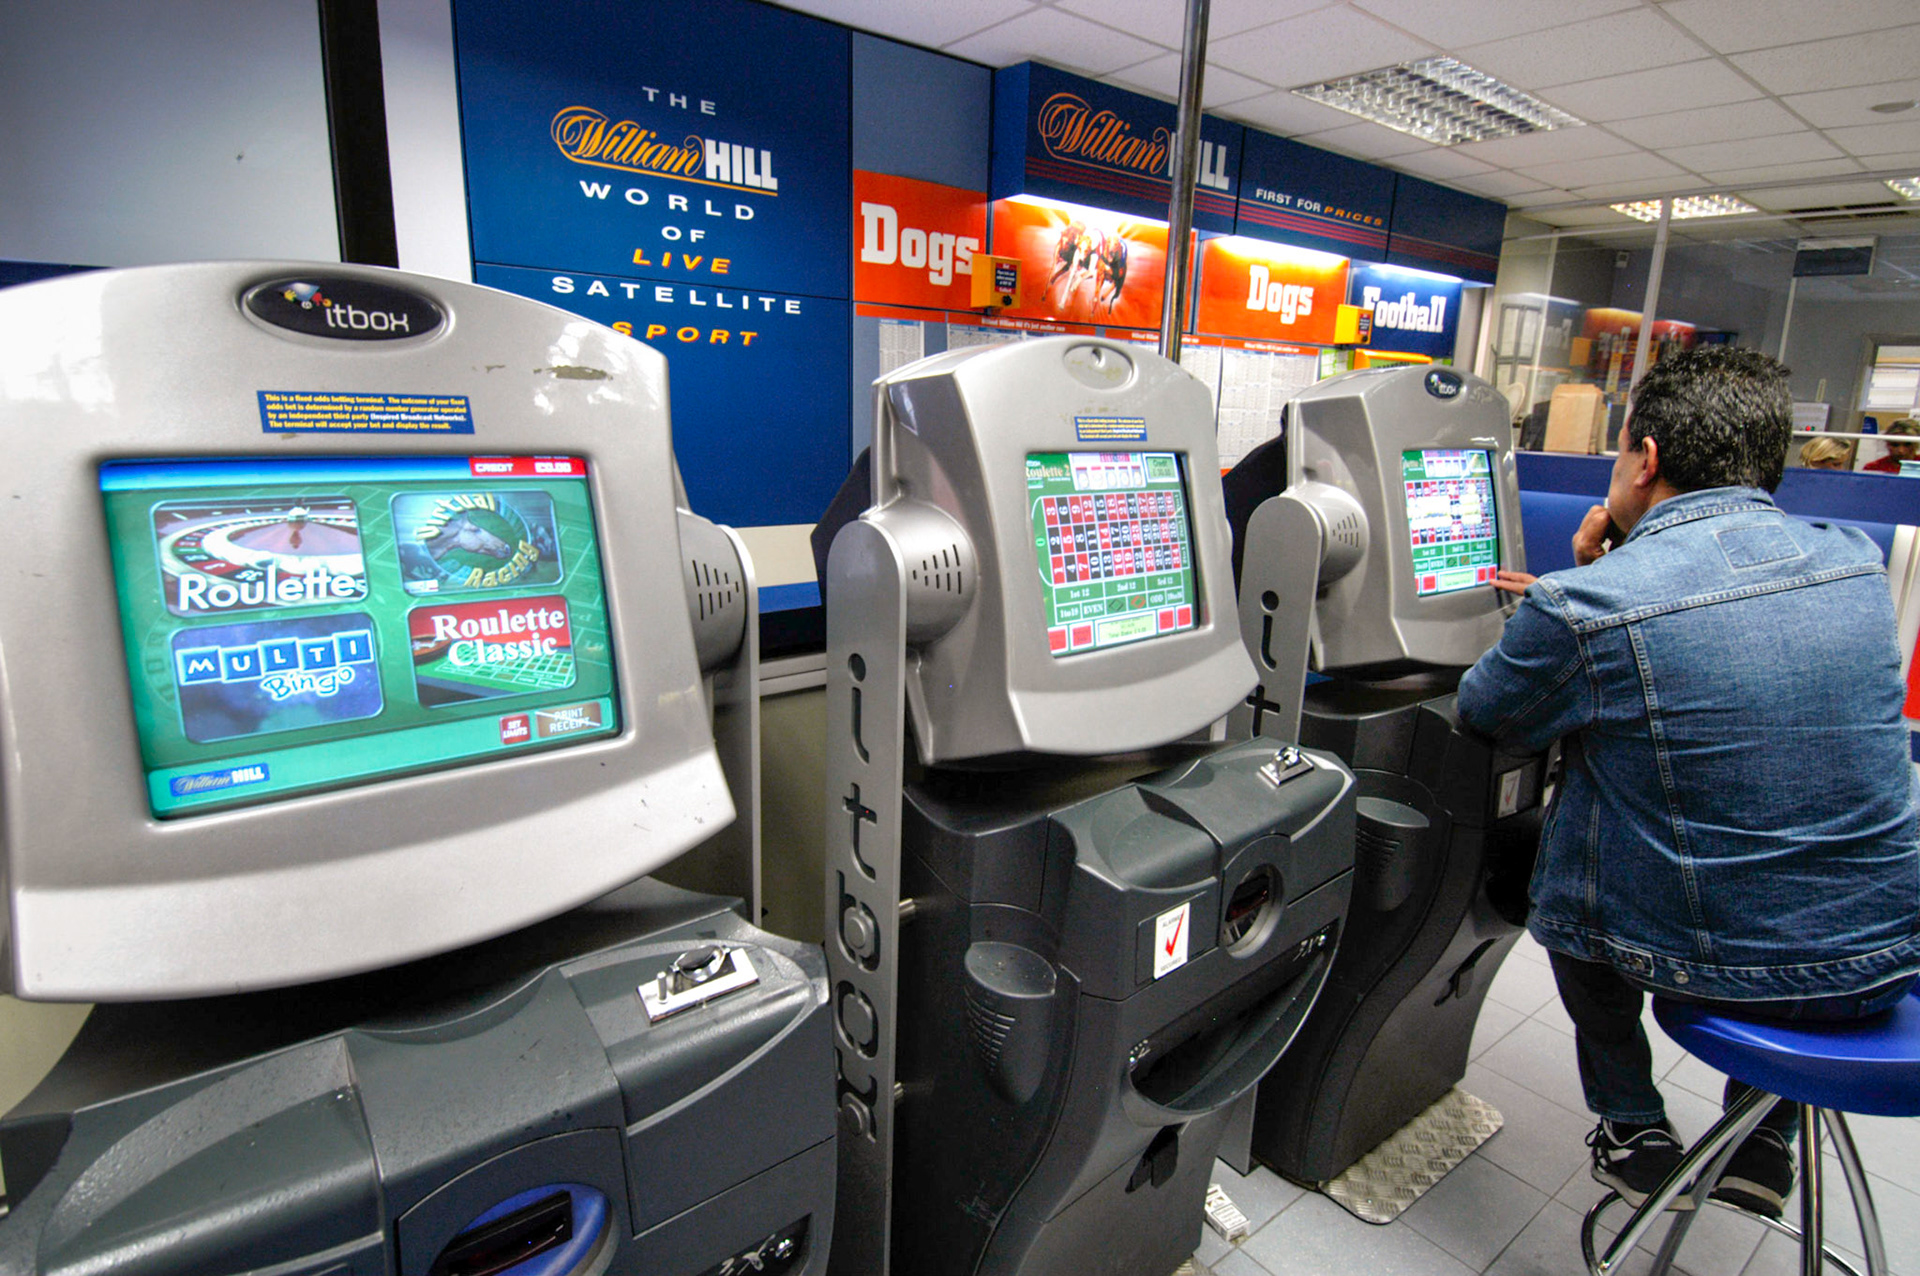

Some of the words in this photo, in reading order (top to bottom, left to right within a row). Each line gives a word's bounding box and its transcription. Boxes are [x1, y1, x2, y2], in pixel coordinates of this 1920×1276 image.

[642, 85, 717, 115] THE
[1037, 92, 1171, 174] William
[551, 105, 706, 177] William
[705, 138, 778, 190] HILL
[579, 180, 755, 220] WORLD
[1256, 188, 1292, 205] FIRST
[1297, 198, 1321, 213] FOR
[1324, 205, 1383, 226] PRICES
[661, 226, 706, 243] OF
[861, 201, 979, 286] Dogs
[632, 248, 732, 274] LIVE
[551, 276, 801, 315] SATELLITE
[1246, 264, 1314, 325] Dogs
[1363, 286, 1447, 333] Football
[325, 306, 410, 333] itbox
[611, 321, 759, 346] SPORT
[1046, 507, 1055, 515] 3
[1059, 506, 1068, 515] 6
[1071, 505, 1080, 514] 9
[1083, 500, 1093, 516] 12
[1096, 500, 1105, 514] 15
[1108, 498, 1116, 513] 18
[1050, 536, 1060, 545] 2
[1063, 535, 1072, 544] 5
[1076, 534, 1084, 543] 8
[1087, 530, 1096, 544] 11
[1101, 528, 1110, 543] 14
[1111, 527, 1119, 541] 17
[464, 539, 540, 589] Racing
[1054, 566, 1064, 574] 1
[1067, 564, 1076, 573] 4
[1079, 563, 1088, 571] 7
[1091, 556, 1100, 573] 10
[1103, 555, 1112, 571] 13
[1114, 554, 1122, 570] 16
[431, 607, 565, 642] Roulette
[188, 640, 358, 675] MULTI
[448, 632, 558, 667] Classic
[260, 666, 355, 701] Bingo
[554, 708, 584, 721] PRINT
[549, 716, 591, 734] RECEIPT
[175, 773, 231, 792] William
[231, 766, 265, 784] HILL
